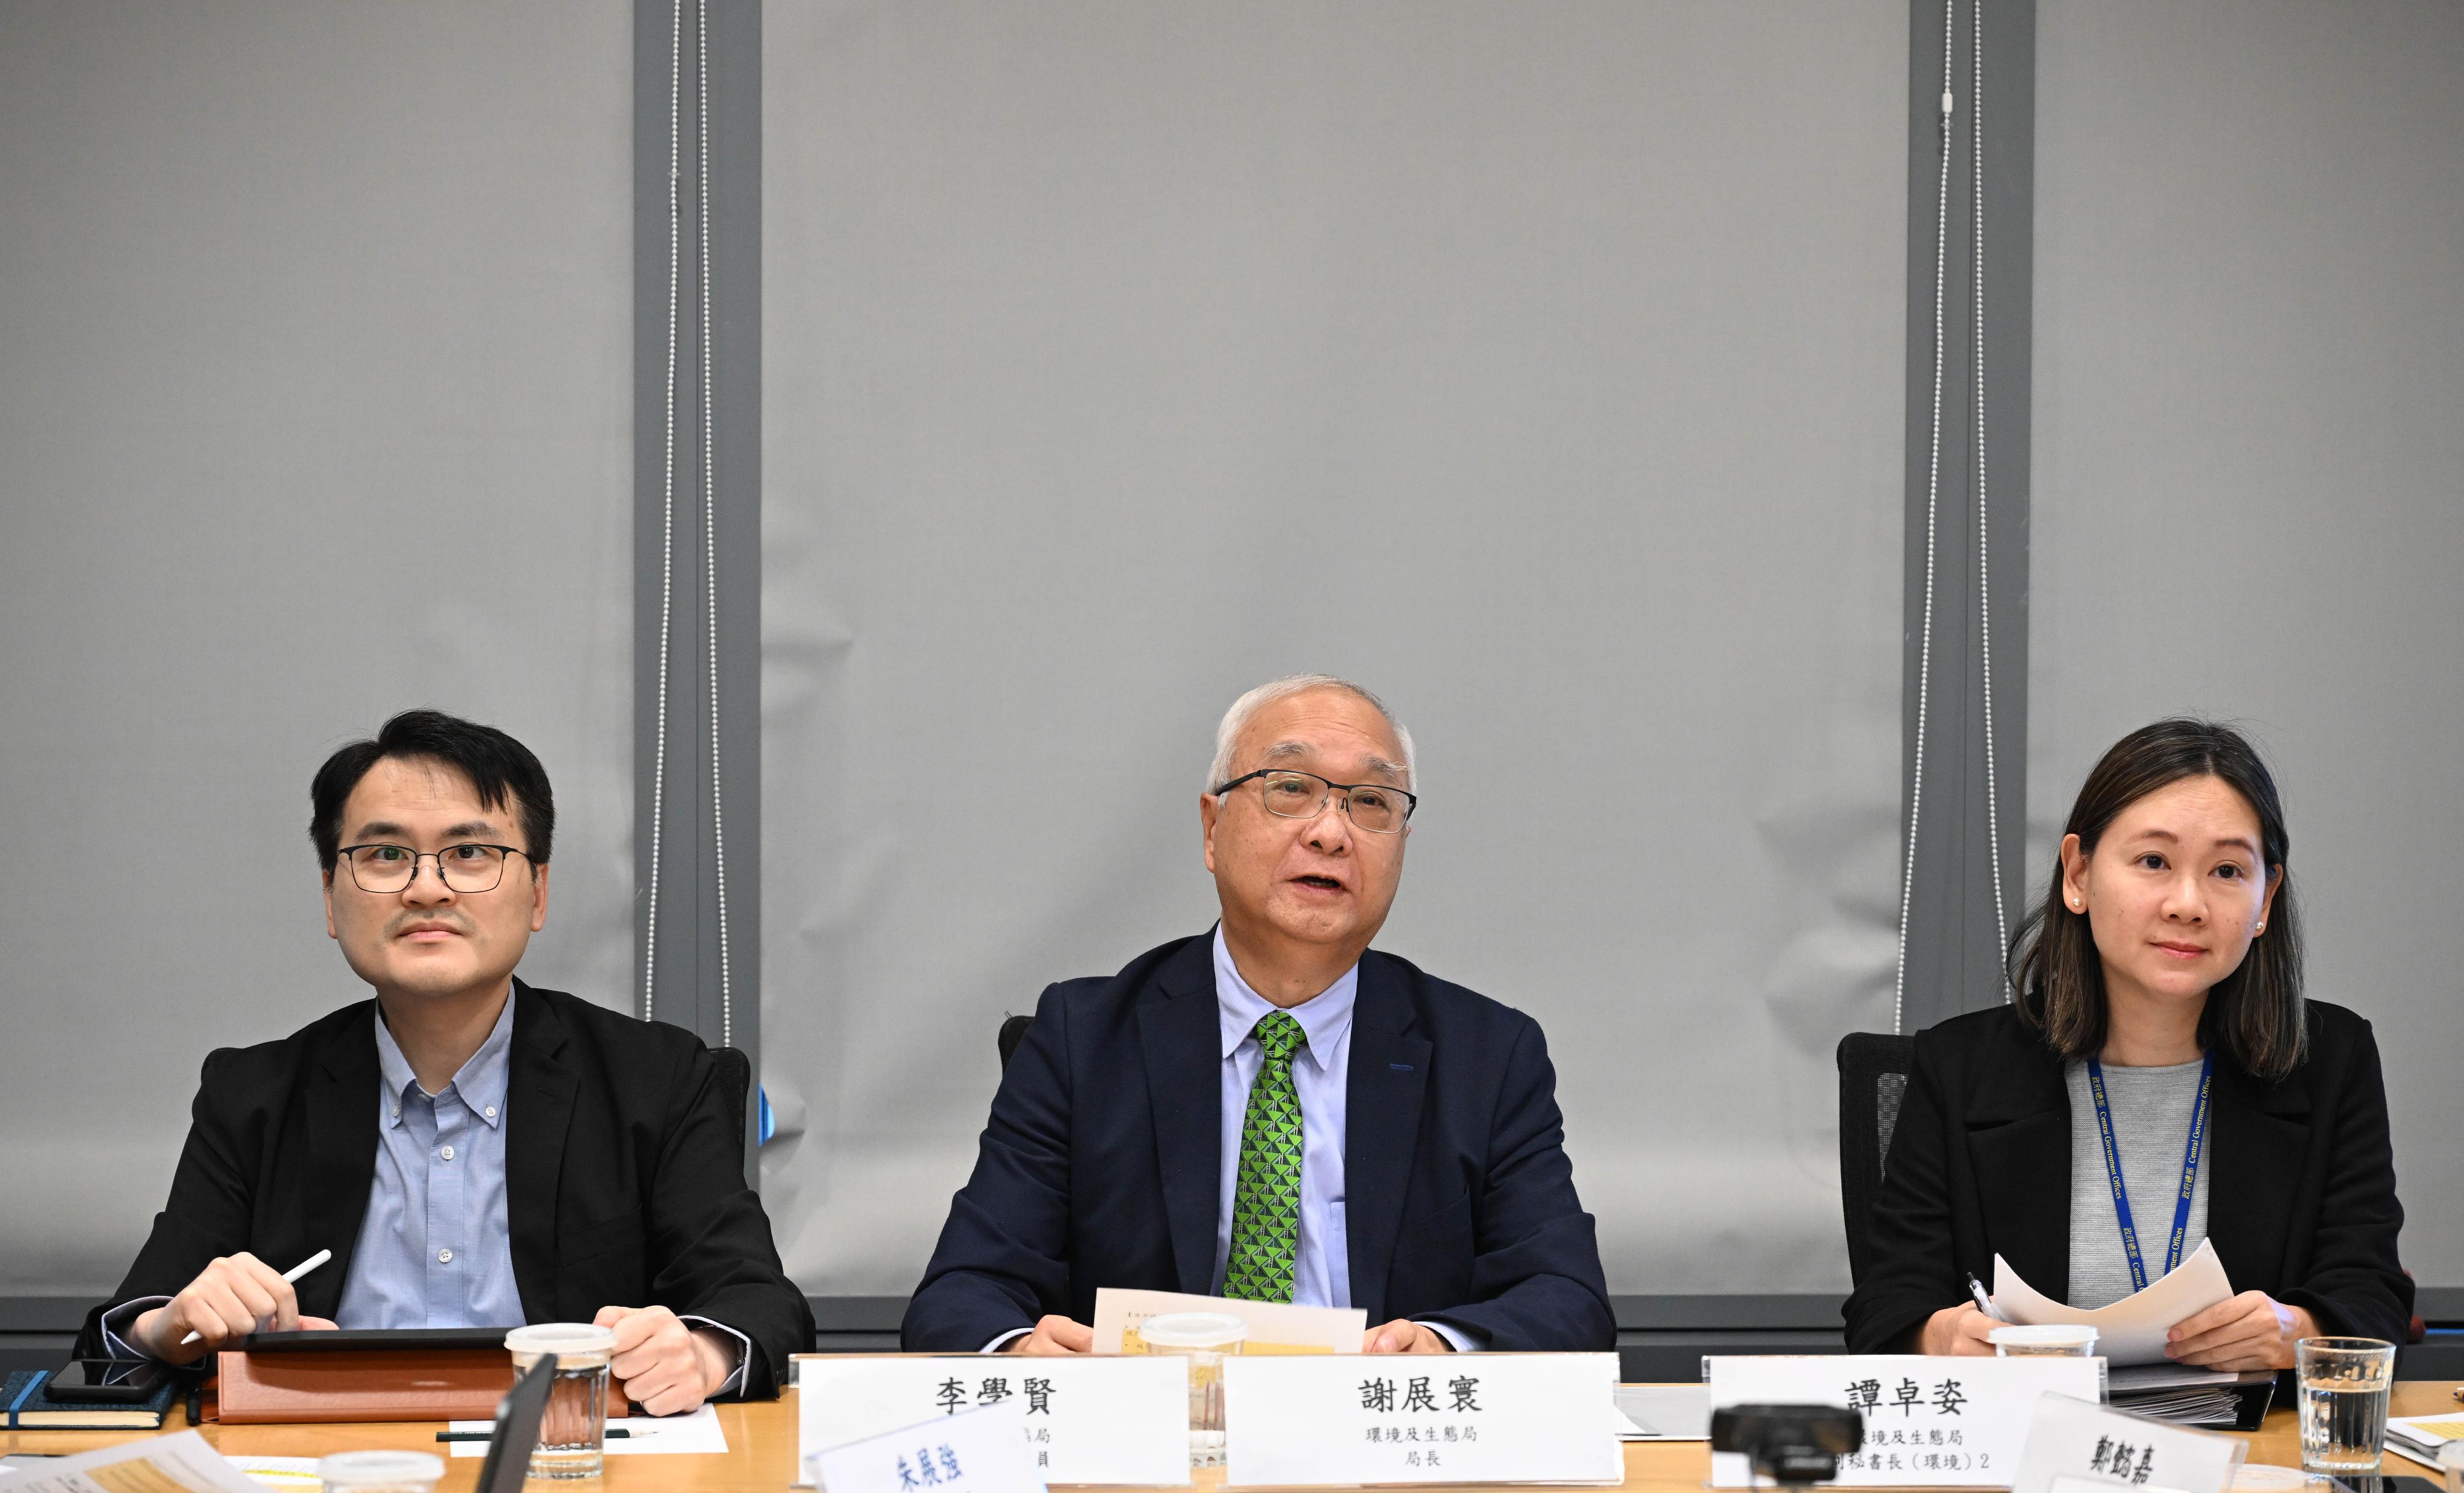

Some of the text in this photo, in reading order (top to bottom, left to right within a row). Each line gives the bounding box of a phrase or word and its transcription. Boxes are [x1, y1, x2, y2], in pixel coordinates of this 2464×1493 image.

[2201, 1075, 2211, 1098] Offices
[2193, 1099, 2207, 1139] Government
[2099, 1111, 2109, 1135] Central
[2104, 1136, 2117, 1175] Government
[2112, 1176, 2122, 1200] Offices
[2189, 1140, 2199, 1163] Central
[2172, 1228, 2182, 1250] Offices
[2133, 1262, 2144, 1286] Central
[936, 1377, 1056, 1415] 李學賢
[1358, 1375, 1483, 1413] 謝展寰
[1844, 1377, 1968, 1417] 譚卓姿
[1365, 1425, 1477, 1443] 環境及生態局
[1405, 1450, 1441, 1467] 局長
